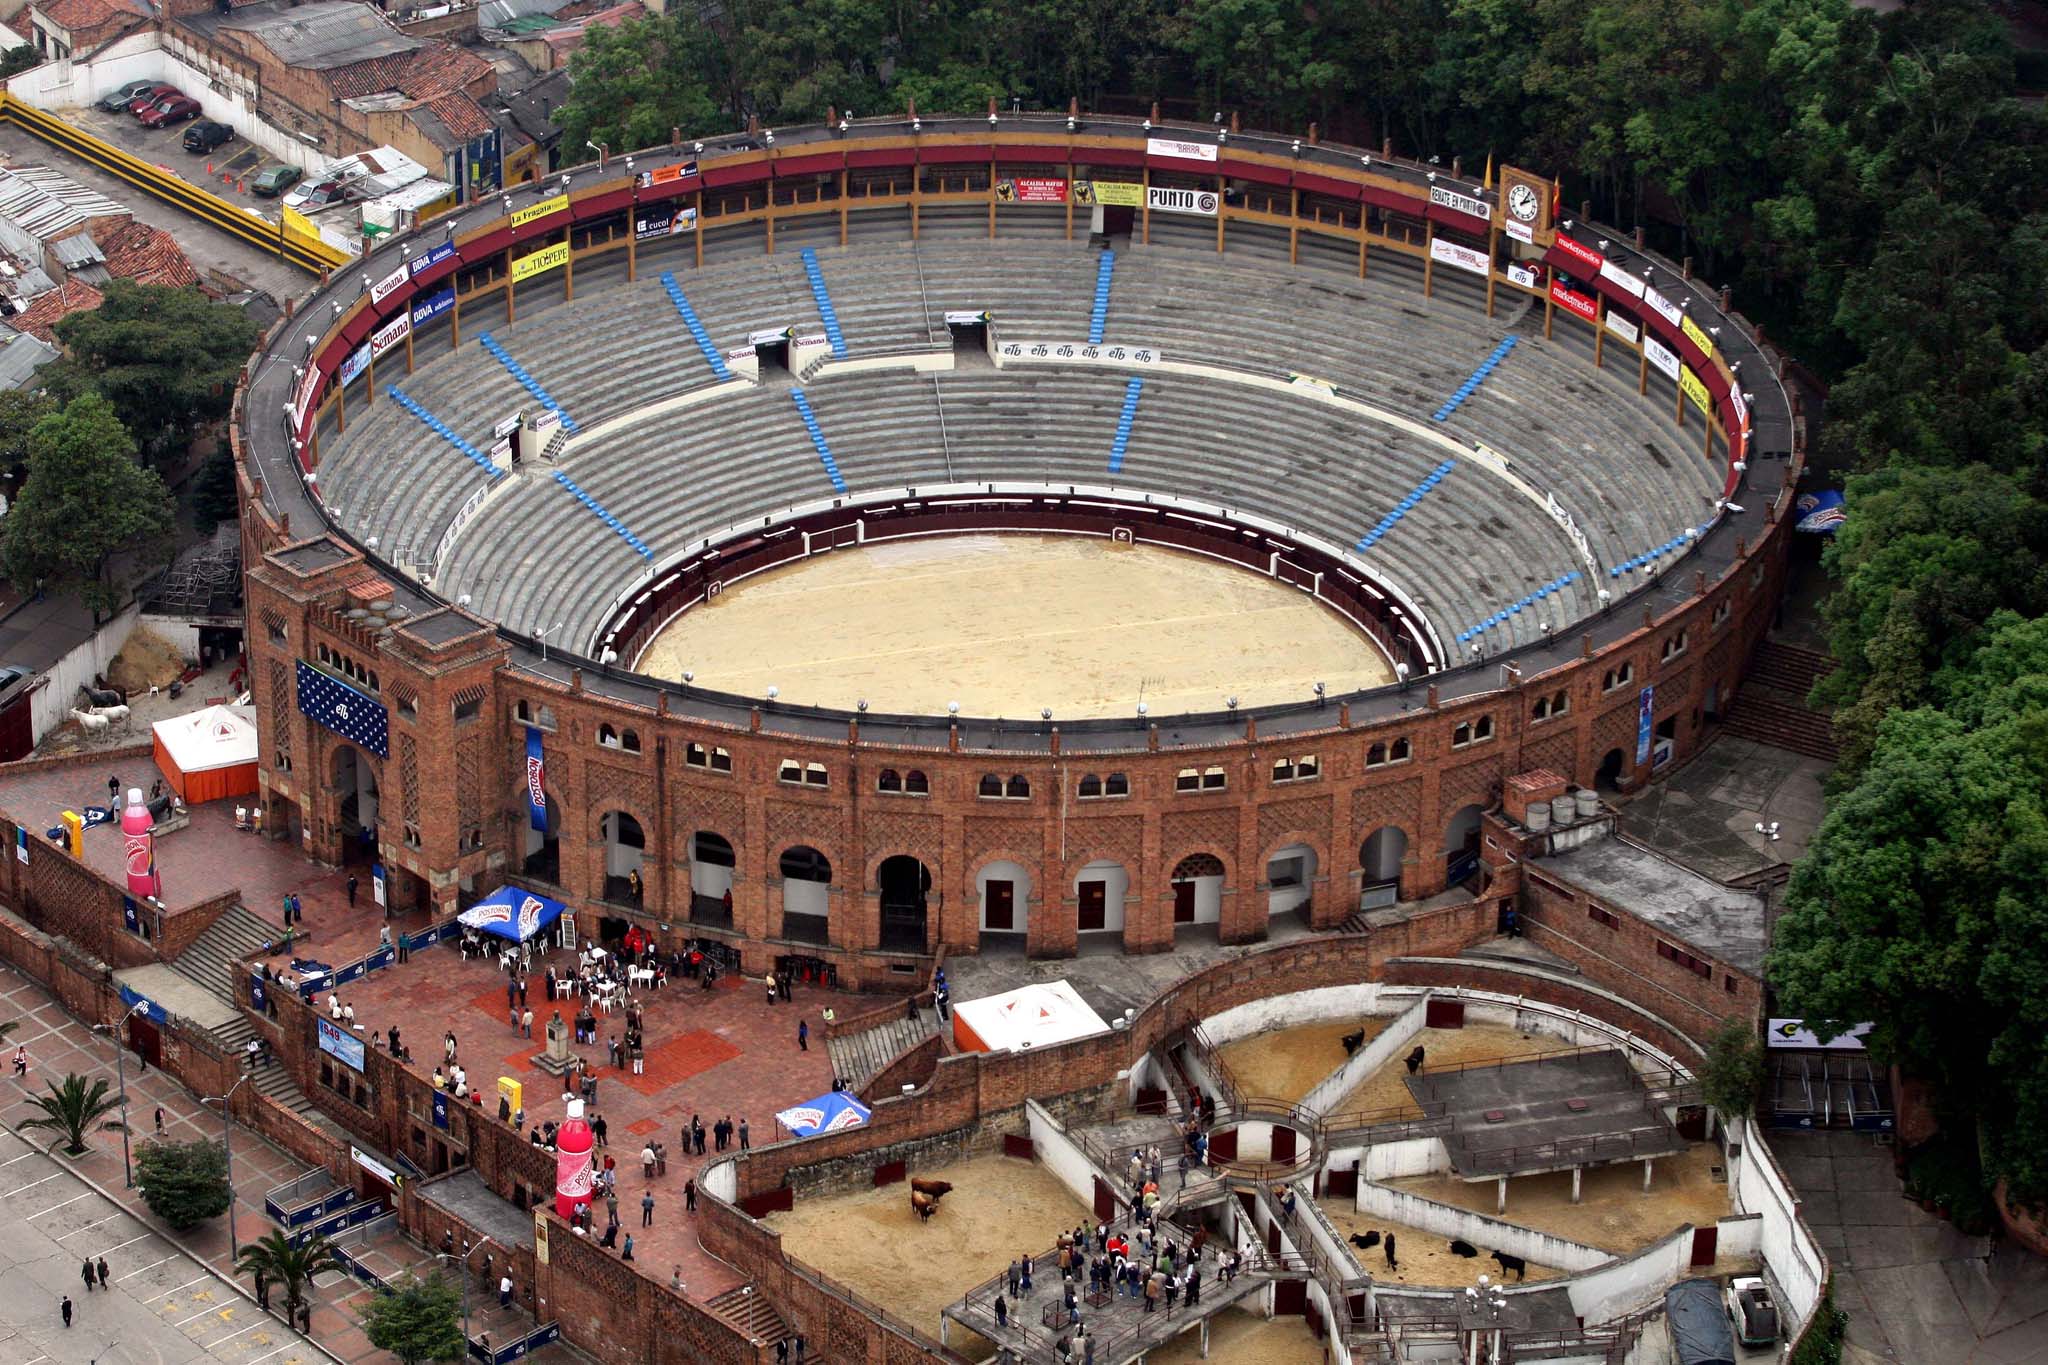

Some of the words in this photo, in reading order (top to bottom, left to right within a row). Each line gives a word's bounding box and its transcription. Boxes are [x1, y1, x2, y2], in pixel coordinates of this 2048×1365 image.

[1149, 189, 1194, 208] PUNTO
[511, 215, 521, 224] La
[1507, 223, 1531, 239] Semana
[412, 255, 430, 273] BBVA
[532, 256, 546, 271] TIO
[548, 247, 567, 264] PEPE
[375, 273, 403, 299] Semana
[1514, 271, 1527, 284] eTb
[413, 304, 433, 323] BBVA
[371, 320, 409, 355] Semana
[797, 338, 825, 347] Semana
[728, 349, 756, 361] Semana
[1005, 344, 1022, 357] eTb
[1031, 344, 1048, 357] eTb
[1057, 344, 1074, 358] eTb
[1082, 346, 1099, 359] eTb
[1108, 347, 1125, 361] eTb
[1134, 349, 1152, 363] eTb
[335, 703, 349, 720] eTb
